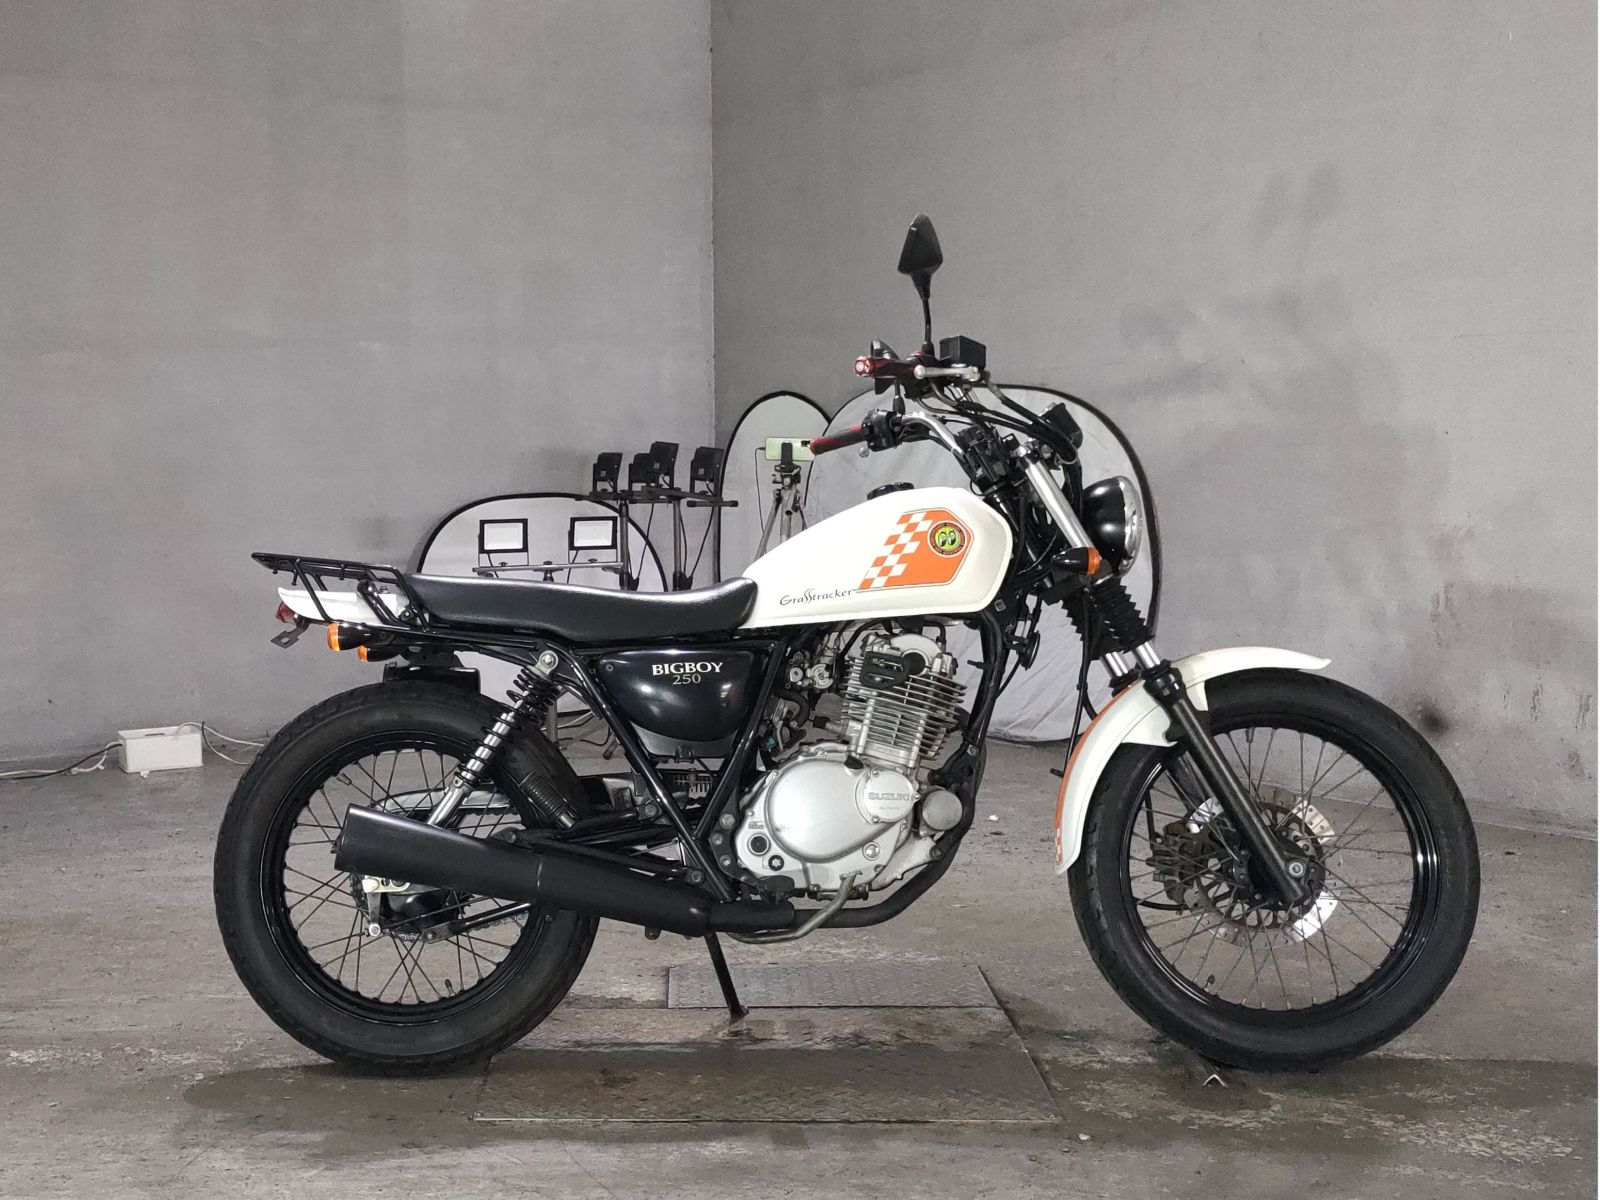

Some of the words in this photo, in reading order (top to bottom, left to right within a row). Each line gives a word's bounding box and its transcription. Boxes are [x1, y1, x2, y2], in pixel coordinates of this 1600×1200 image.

[652, 661, 723, 676] BIGBOY
[672, 673, 702, 685] 250
[868, 791, 911, 801] SUZUKI
